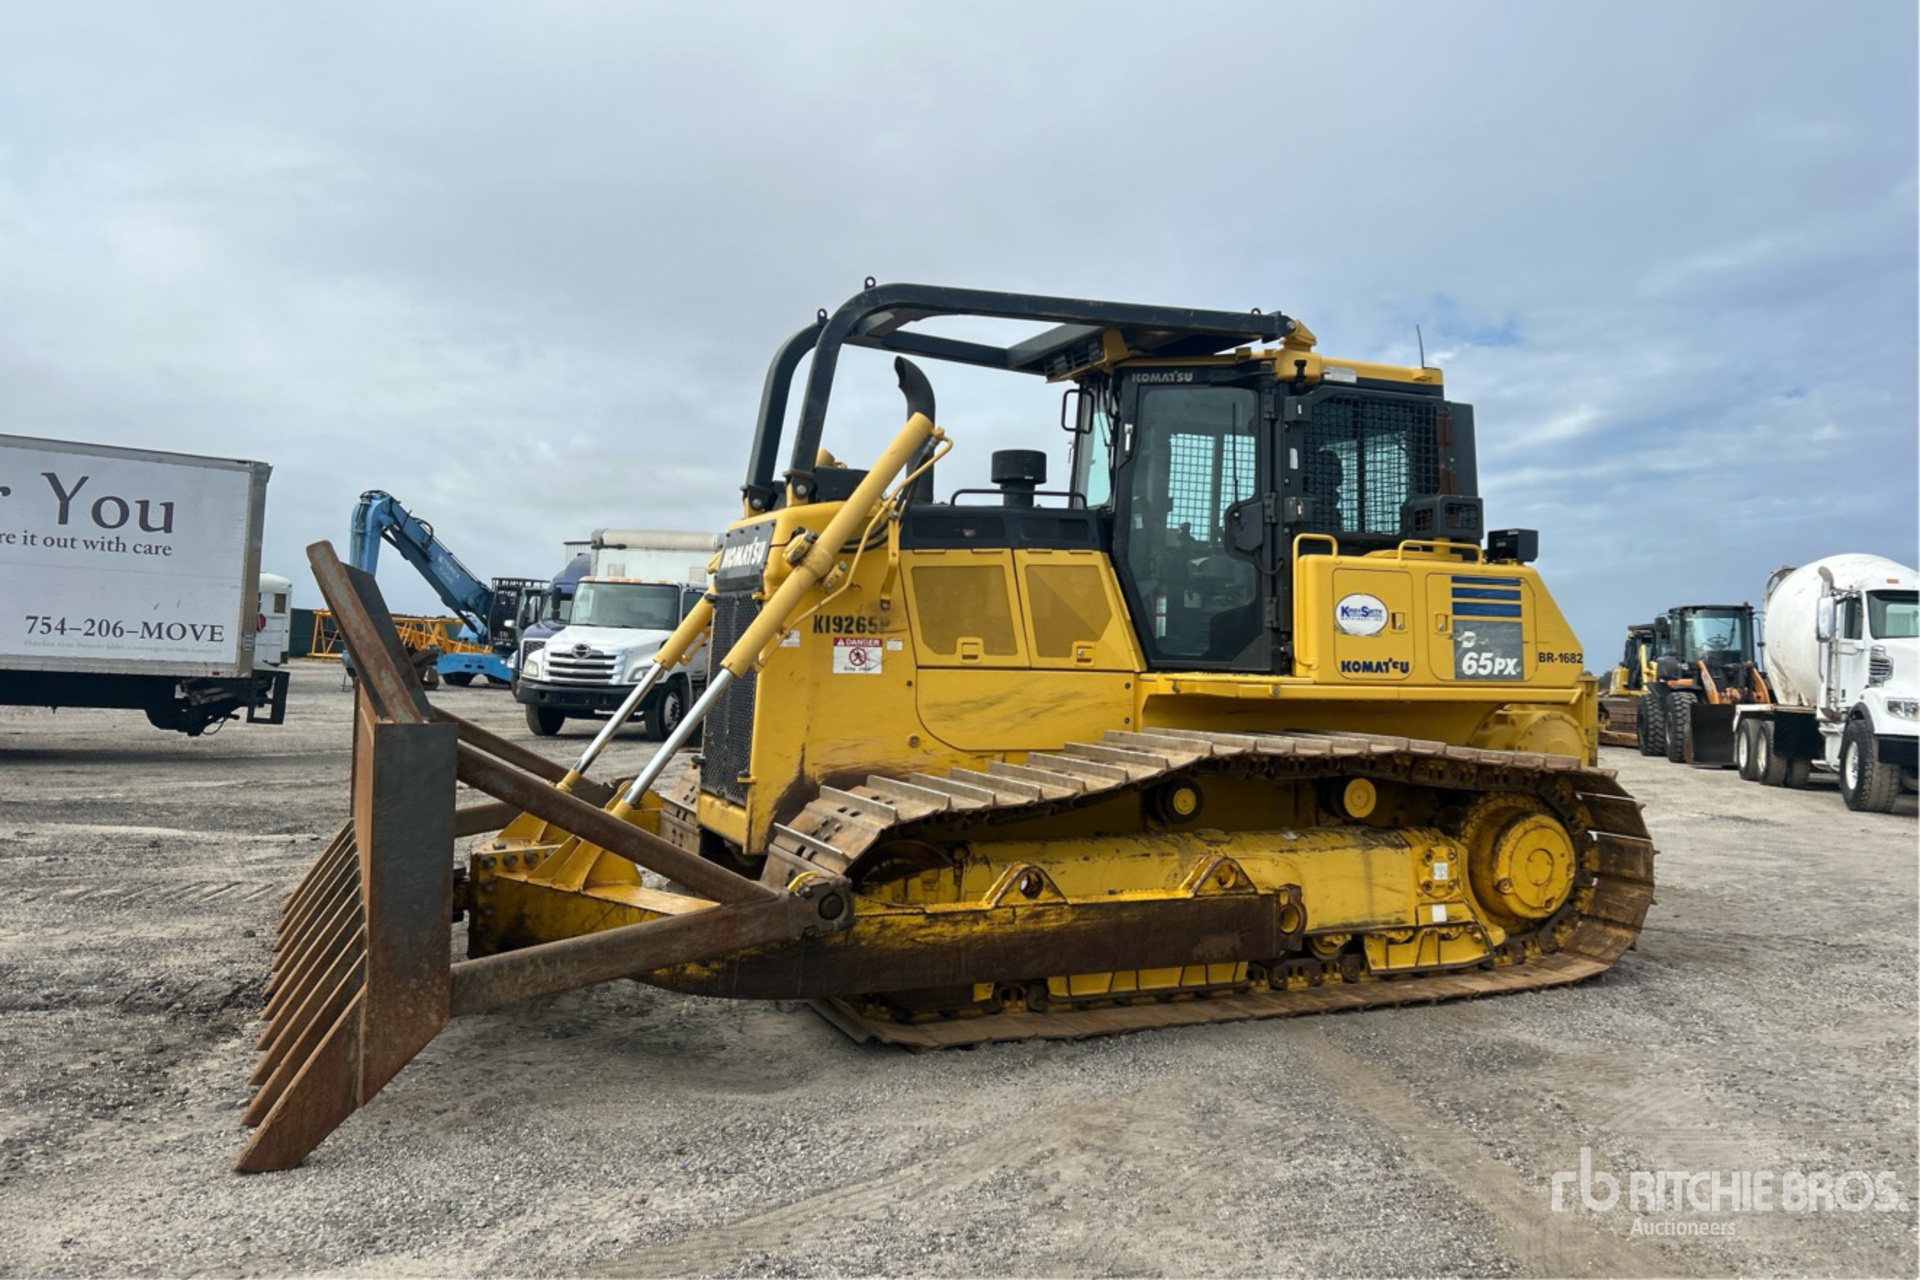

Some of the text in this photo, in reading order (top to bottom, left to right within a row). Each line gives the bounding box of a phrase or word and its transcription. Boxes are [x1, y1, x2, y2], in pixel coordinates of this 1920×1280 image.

[1131, 370, 1194, 383] KOMATSU
[41, 472, 174, 533] You
[22, 529, 38, 546] it
[42, 534, 78, 550] out
[82, 535, 127, 553] with
[132, 542, 172, 556] care
[721, 536, 767, 569] KOMATSU
[845, 638, 880, 647] DANGER
[1461, 652, 1518, 676] 65PX
[1538, 652, 1584, 664] BR-1682
